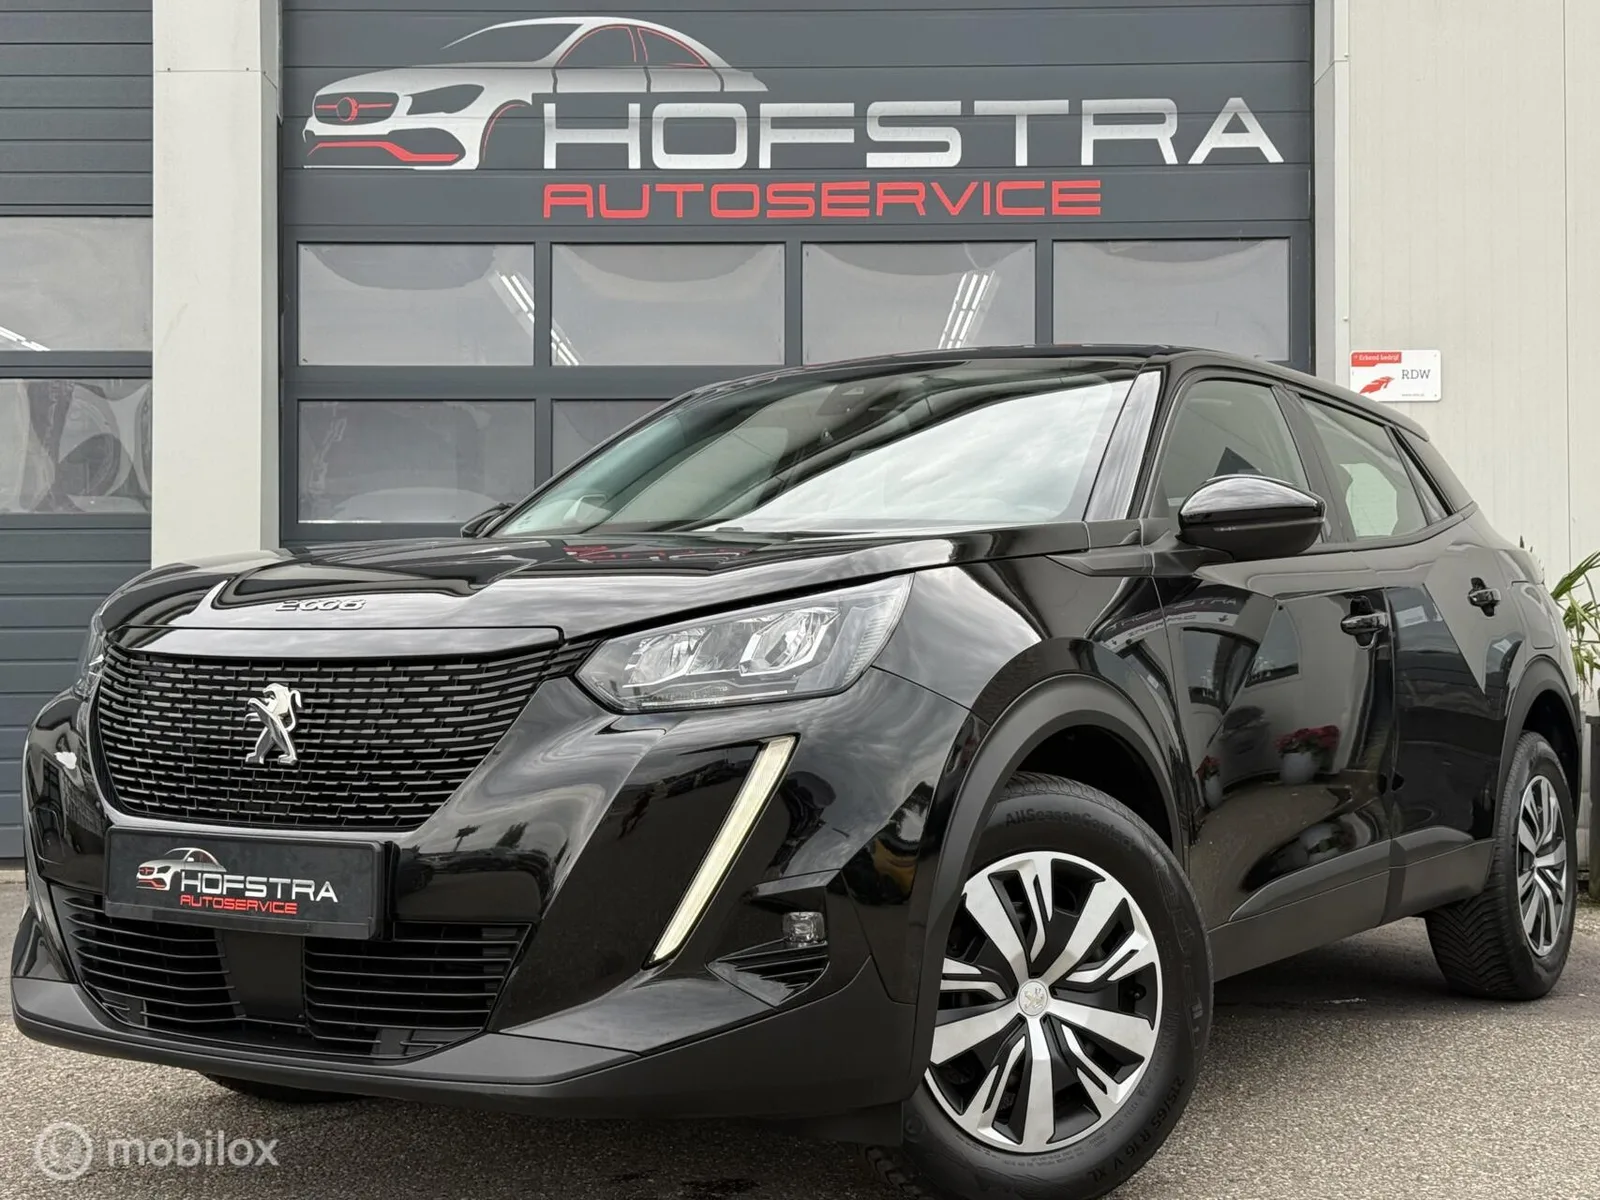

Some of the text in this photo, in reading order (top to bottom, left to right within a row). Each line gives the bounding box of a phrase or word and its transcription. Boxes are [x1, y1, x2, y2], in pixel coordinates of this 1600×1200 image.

[543, 97, 1284, 170] HOFSTRA
[543, 180, 1102, 219] AUTOSERVICE
[1401, 369, 1431, 380] RDW
[180, 870, 338, 903] HOFSTRA
[180, 894, 298, 914] AUTOSERVICE
